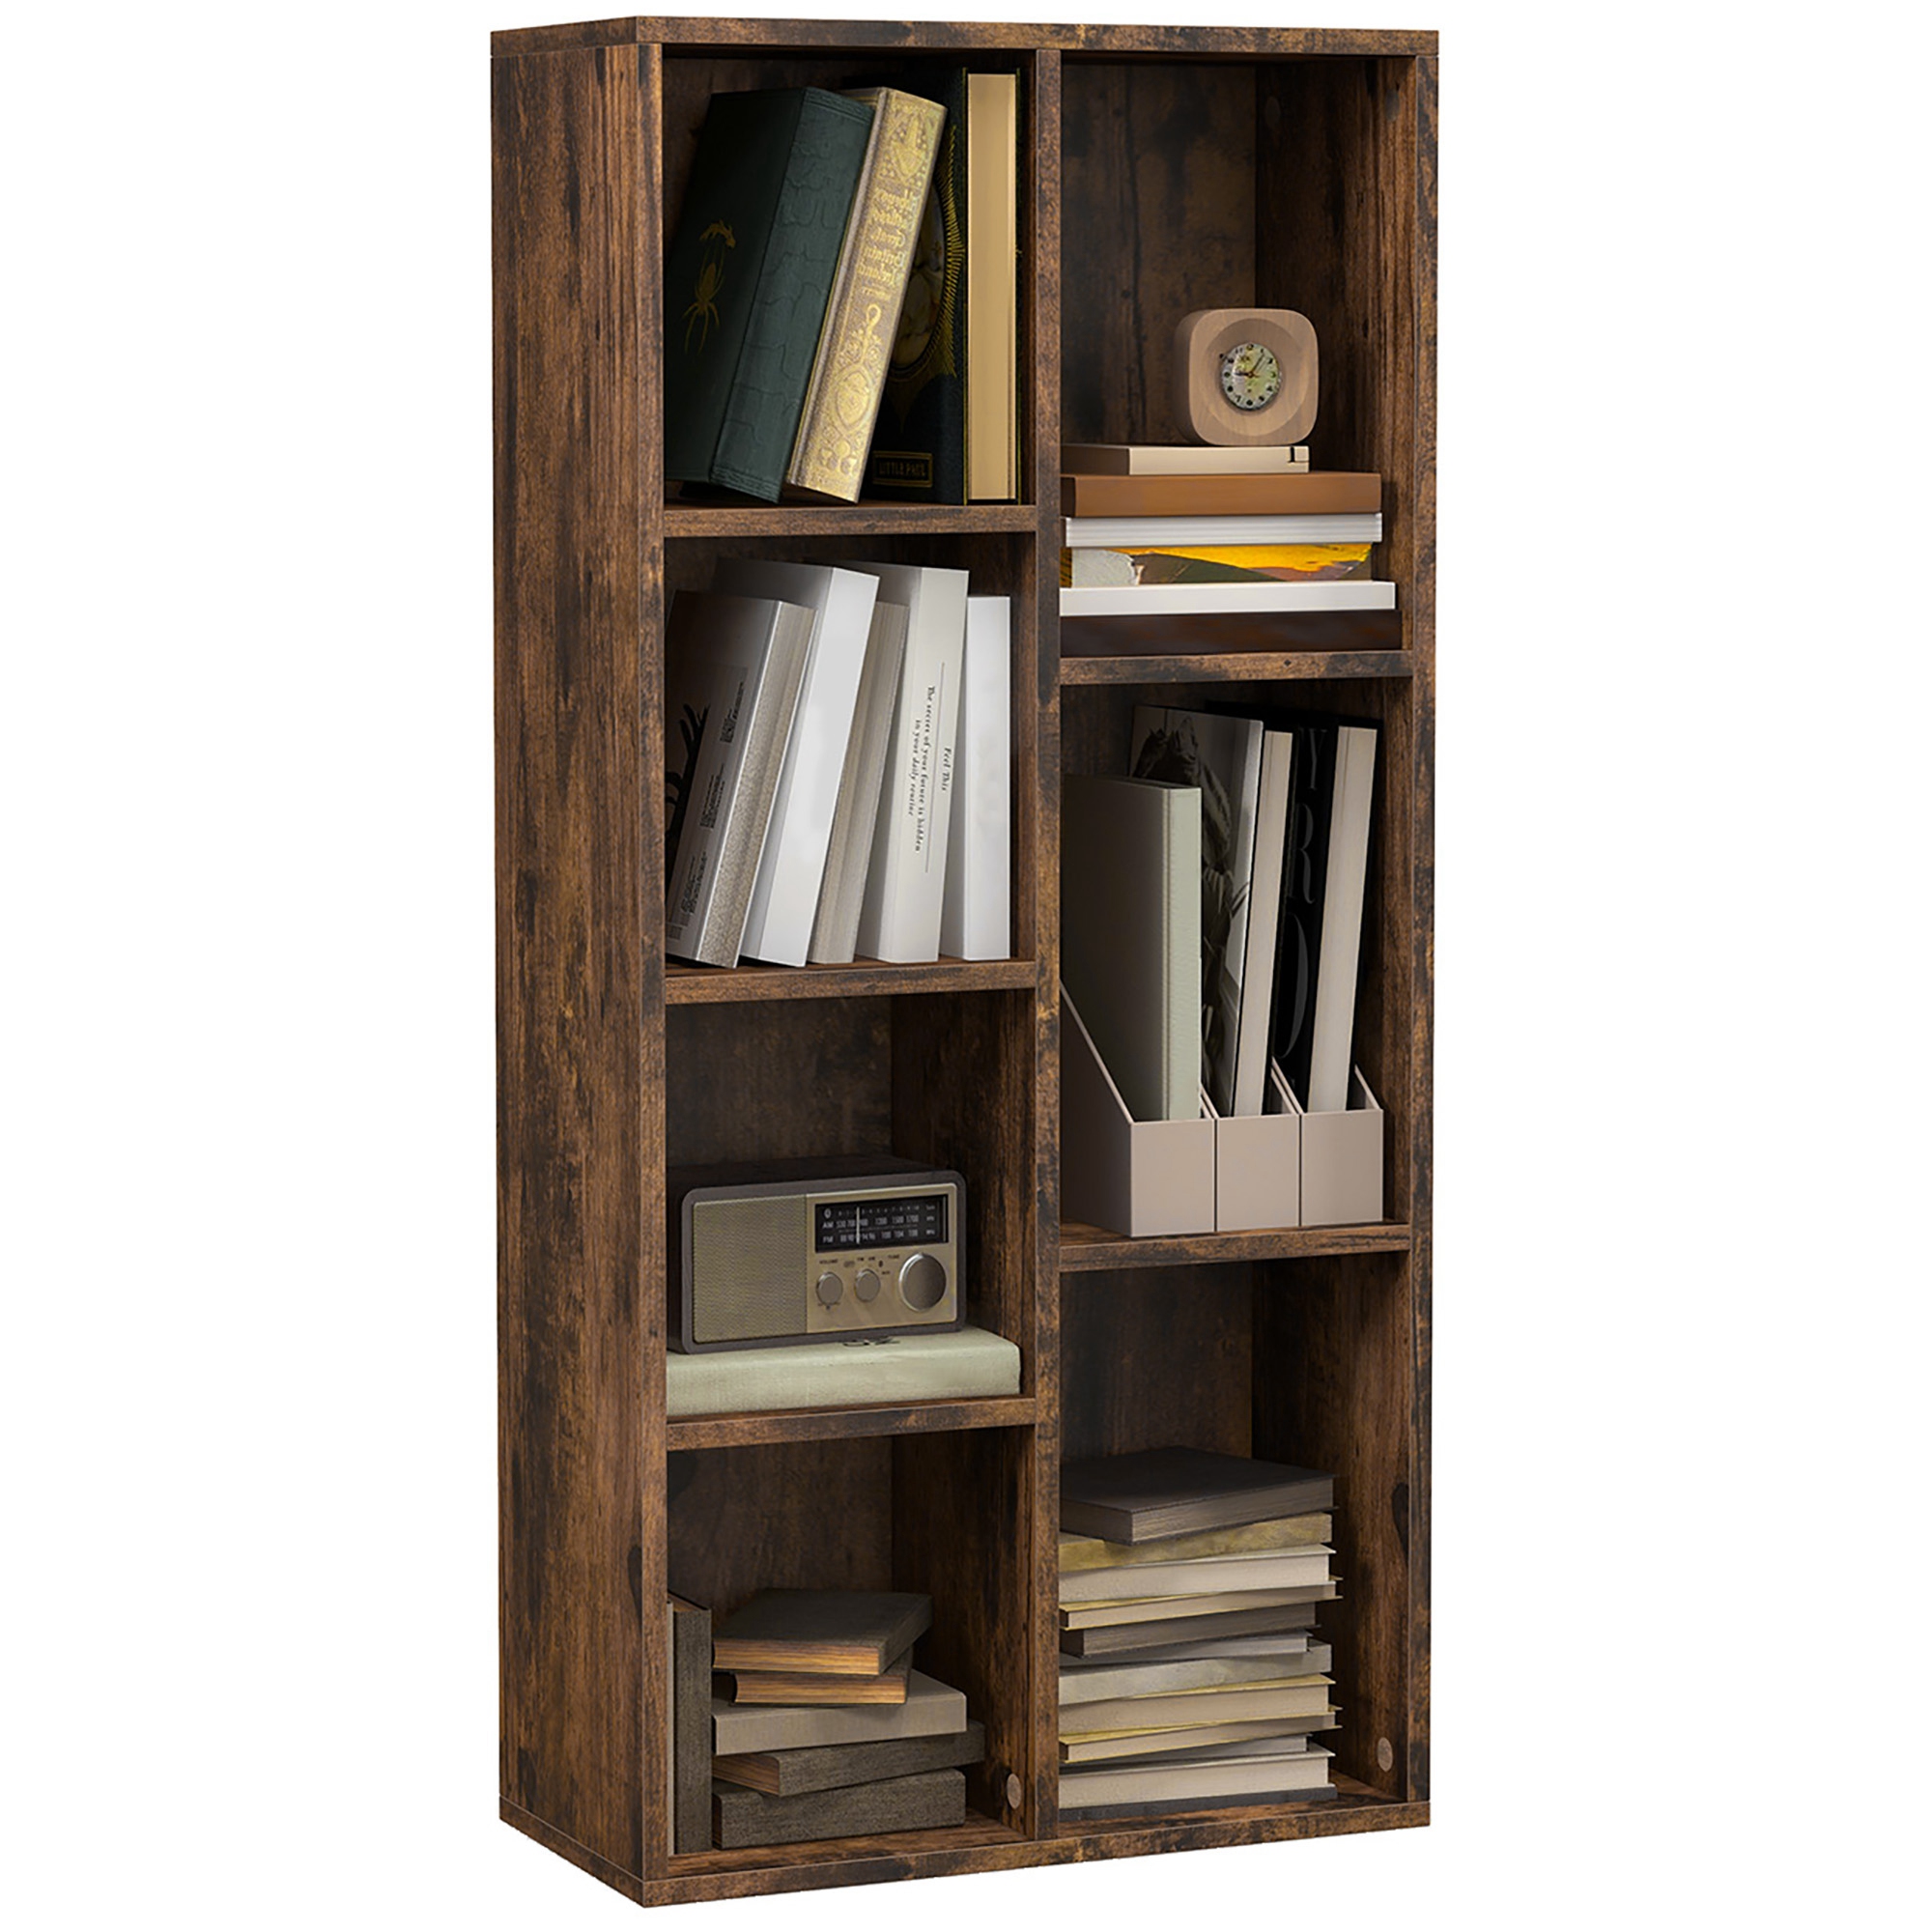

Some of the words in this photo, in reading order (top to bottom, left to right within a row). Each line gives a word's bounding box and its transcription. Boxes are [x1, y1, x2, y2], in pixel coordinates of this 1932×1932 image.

[926, 685, 936, 701] The
[915, 720, 922, 730] in
[923, 736, 931, 748] of
[921, 748, 929, 771] your
[942, 747, 952, 768] Feel
[908, 756, 920, 781] daily
[918, 773, 928, 804] future
[941, 772, 951, 791] This
[918, 807, 924, 815] is
[915, 818, 925, 852] hidden
